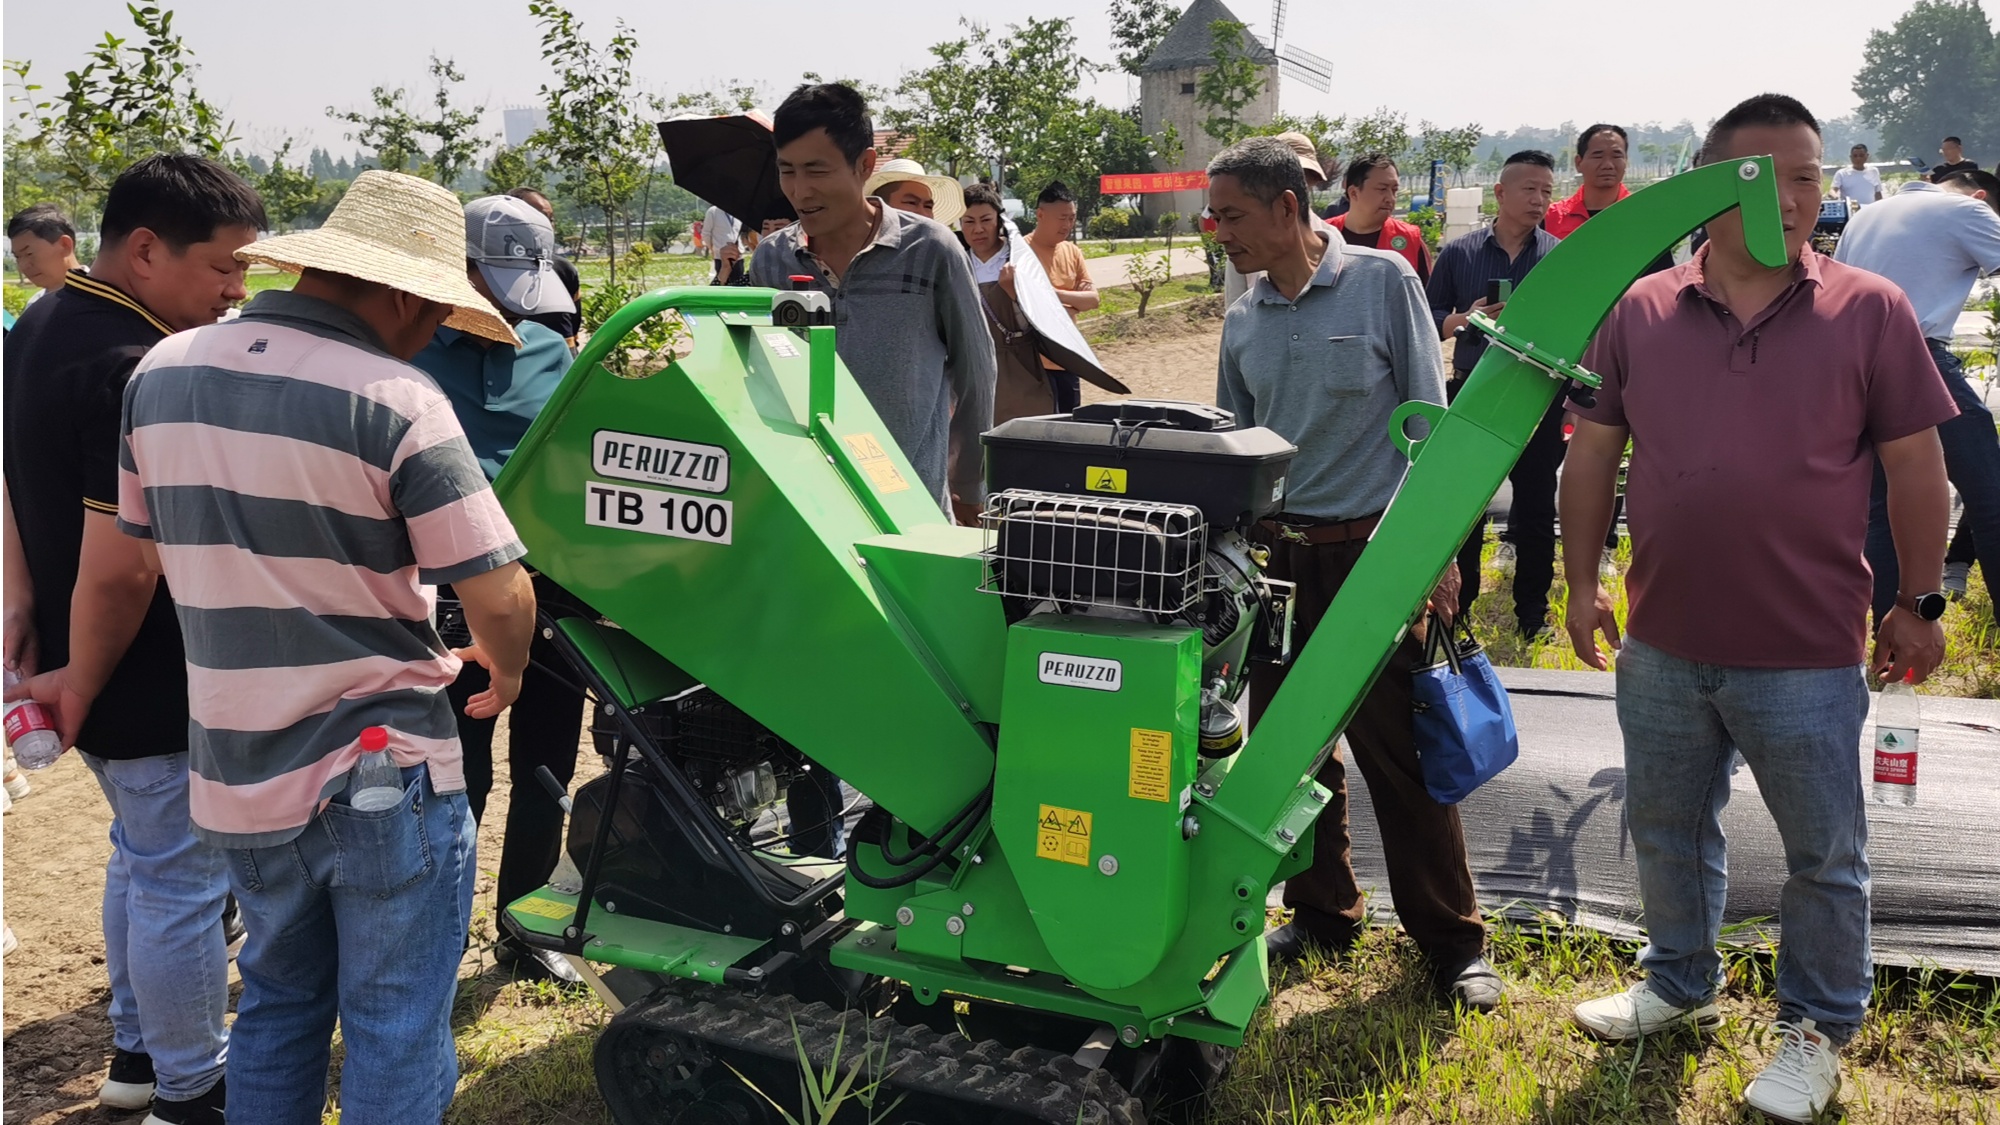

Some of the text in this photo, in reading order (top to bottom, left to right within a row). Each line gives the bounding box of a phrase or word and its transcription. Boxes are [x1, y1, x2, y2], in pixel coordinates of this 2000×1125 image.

[602, 440, 719, 482] PERUZZO
[590, 487, 727, 538] TB 100
[1044, 660, 1116, 682] PERUZZO
